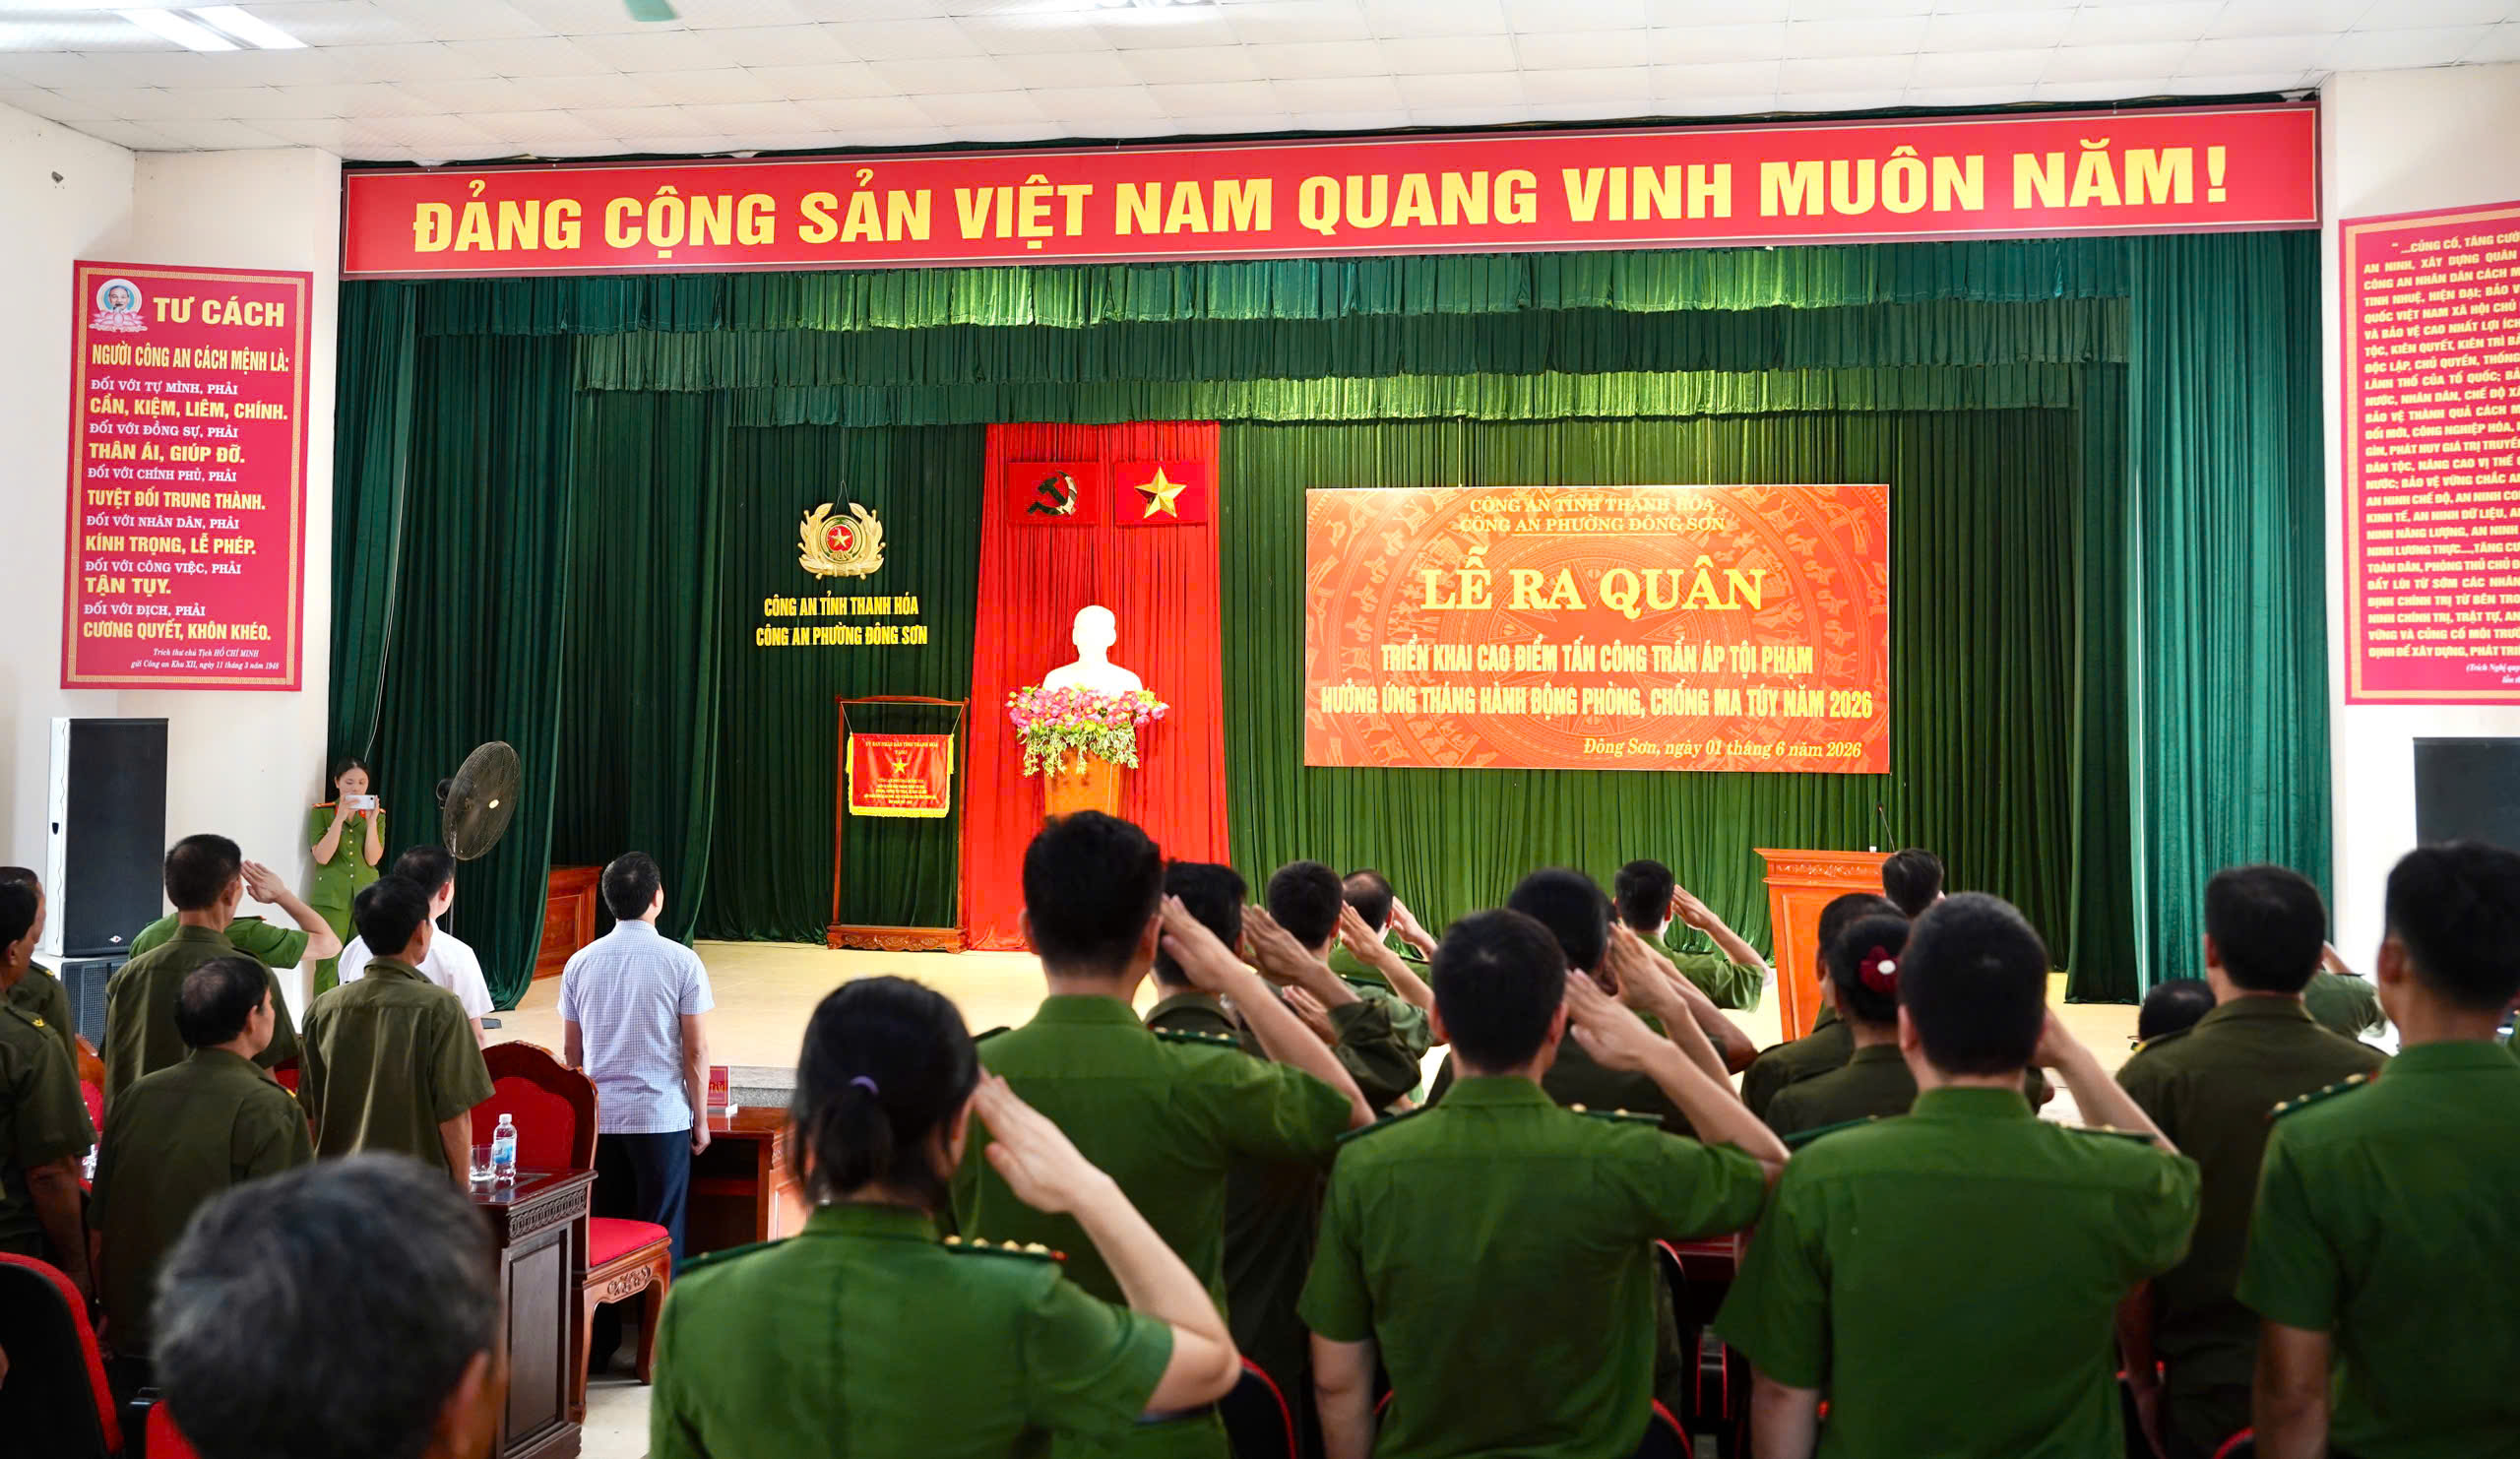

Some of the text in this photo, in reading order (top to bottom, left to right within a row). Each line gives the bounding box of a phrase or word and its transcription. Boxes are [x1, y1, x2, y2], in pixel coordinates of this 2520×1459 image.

[412, 137, 2227, 258] ĐẢNG CỘNG SẢN VIỆT NAM QUANG VINH MUÔN NĂM!
[2396, 277, 2413, 287] AN
[154, 295, 284, 327] TƯ CÁCH
[93, 341, 288, 375] NGƯỜI CÔNG AN CÁCH MỆNH LÀ:
[92, 376, 238, 395] ĐỐI VỚI TỰ MÌNH, PHẢI
[91, 393, 287, 419] CẦN, KIỆM, LIÊM, CHÍNH.
[90, 419, 238, 438] ĐỐI VỚI ĐỒNG SỰ, PHẢI
[89, 441, 245, 463] THÂN ÁI, GIÚP ĐỠ.
[88, 464, 236, 481] ĐỐI VỚI CHÍNH PHỦ, PHẢI
[88, 486, 266, 510] TUYỆT ĐỐI TRUNG THÀNH.
[1470, 496, 1520, 513] CÔNG
[1526, 498, 1553, 512] AN
[1605, 497, 1671, 511] THANH
[87, 512, 239, 529] ĐỐI VỚI NHÂN DÂN, PHẢI
[1459, 514, 1725, 533] CÔNG AN PHƯỜNG ĐÔNG SƠN
[86, 533, 256, 555] KÍNH TRỌNG, LỄ PHÉP.
[86, 557, 241, 575] ĐỐI VỚI CÔNG VIỆC, PHẢI
[85, 574, 171, 597] TẬN TỤY.
[1419, 545, 1767, 619] LỄ RA QUÂN
[85, 601, 206, 617] ĐỐI VỚI ĐỊCH, PHẢI
[764, 590, 918, 616] CÔNG AN TỈNH THANH HÓA
[84, 618, 271, 641] CƯƠNG QUYẾT, KHÔN KHÉO.
[756, 621, 928, 646] CÔNG AN PHƯỜNG ĐÔNG SƠN
[1381, 633, 1813, 679] TRIỂN KHAI CAO ĐIỂM TẤN CÔNG TRẤN ÁP TỘI PHẠM
[1321, 677, 1872, 721] HƯỞNG ỨNG THÁNG HÀNH ĐỘNG PHÒNG, CHỐNG MA TÚY NĂM 2026
[1584, 737, 1861, 760] Đông Sơn, ngày 01 tháng 6 năm 2026
